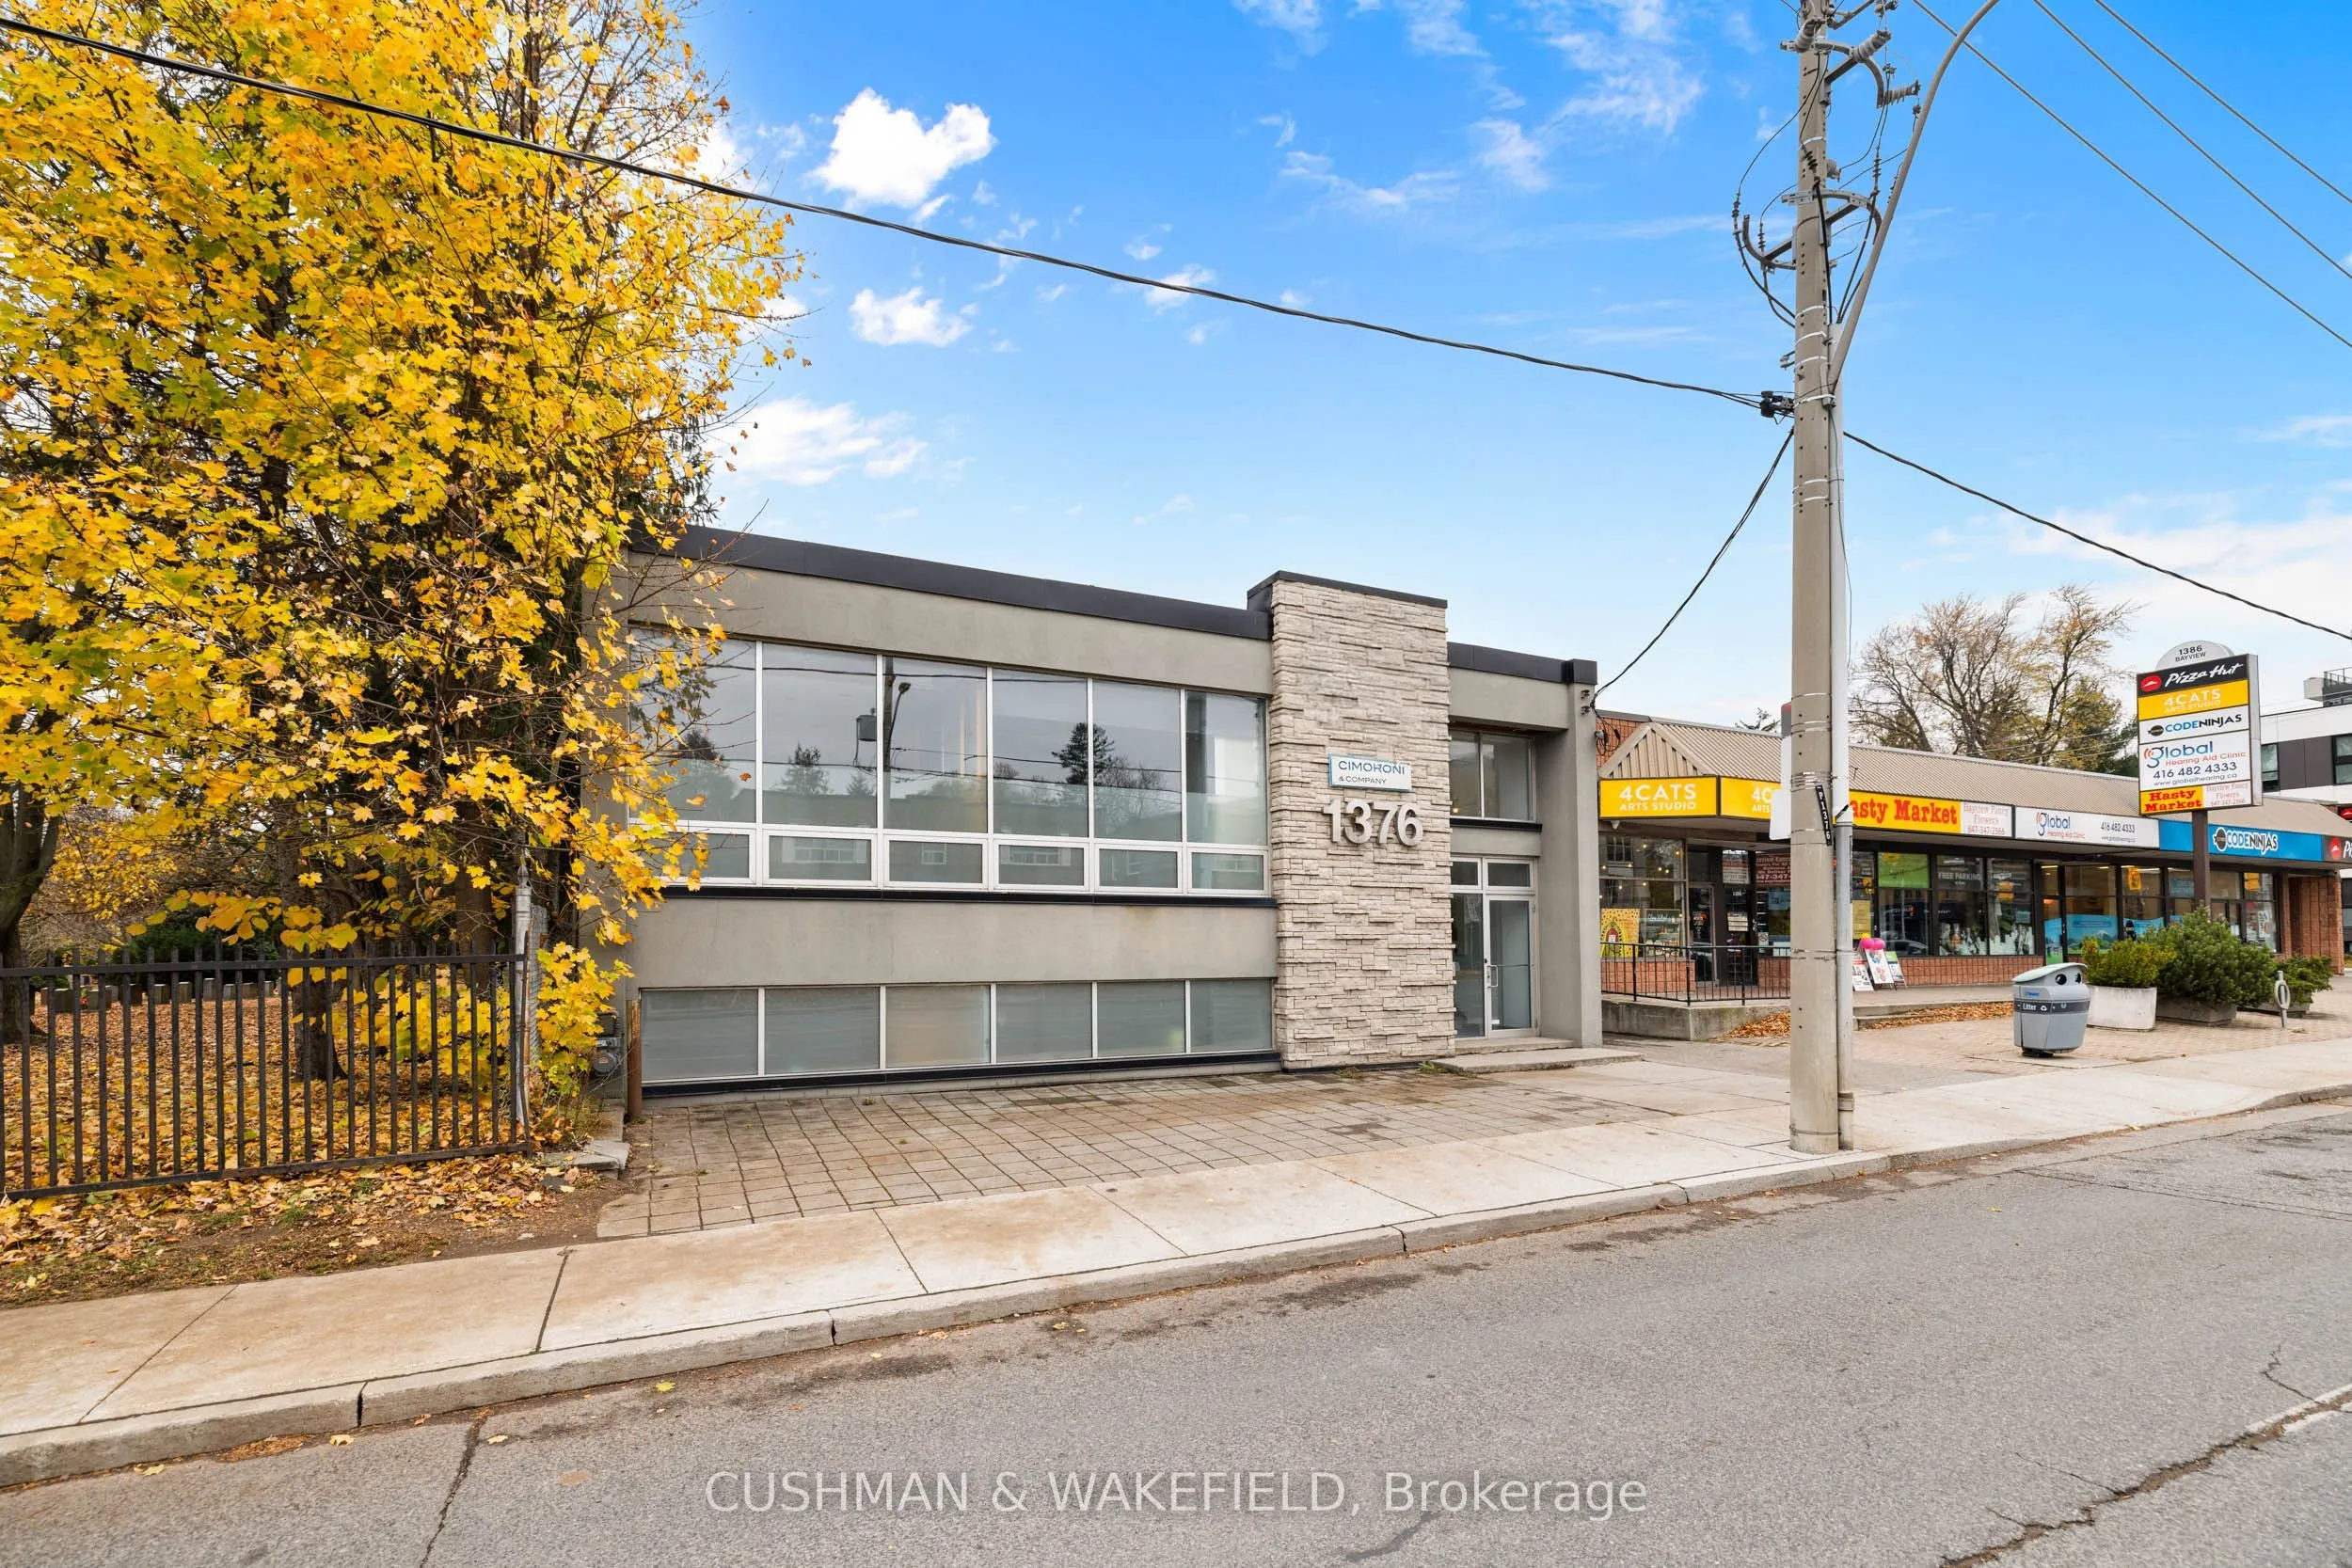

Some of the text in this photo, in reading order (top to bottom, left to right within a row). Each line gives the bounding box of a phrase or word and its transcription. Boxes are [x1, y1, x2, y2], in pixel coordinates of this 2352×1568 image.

[2175, 652, 2206, 662] BAYVIEW
[2179, 645, 2202, 656] 1386
[2165, 662, 2244, 688] Pizza Hut
[2165, 689, 2221, 706] 4CATS
[2165, 701, 2221, 713] ARTS STUDIO
[2146, 740, 2214, 768] global
[2165, 752, 2247, 767] Hearing Aid Clinic
[1338, 760, 1406, 775] CIMORONI
[2153, 761, 2237, 780] 416 482 4333
[1345, 775, 1387, 784] COMPANY
[1618, 784, 1697, 802] 4CATS
[2149, 789, 2197, 801] Hasty
[1618, 801, 1697, 812] ARTS STUDIO
[1751, 804, 1771, 813] ARTS
[1849, 798, 1958, 825] asty Market
[2144, 800, 2202, 813] Market
[1323, 798, 1423, 847] 1376
[2038, 812, 2071, 836] global
[2023, 1003, 2037, 1011] Litter
